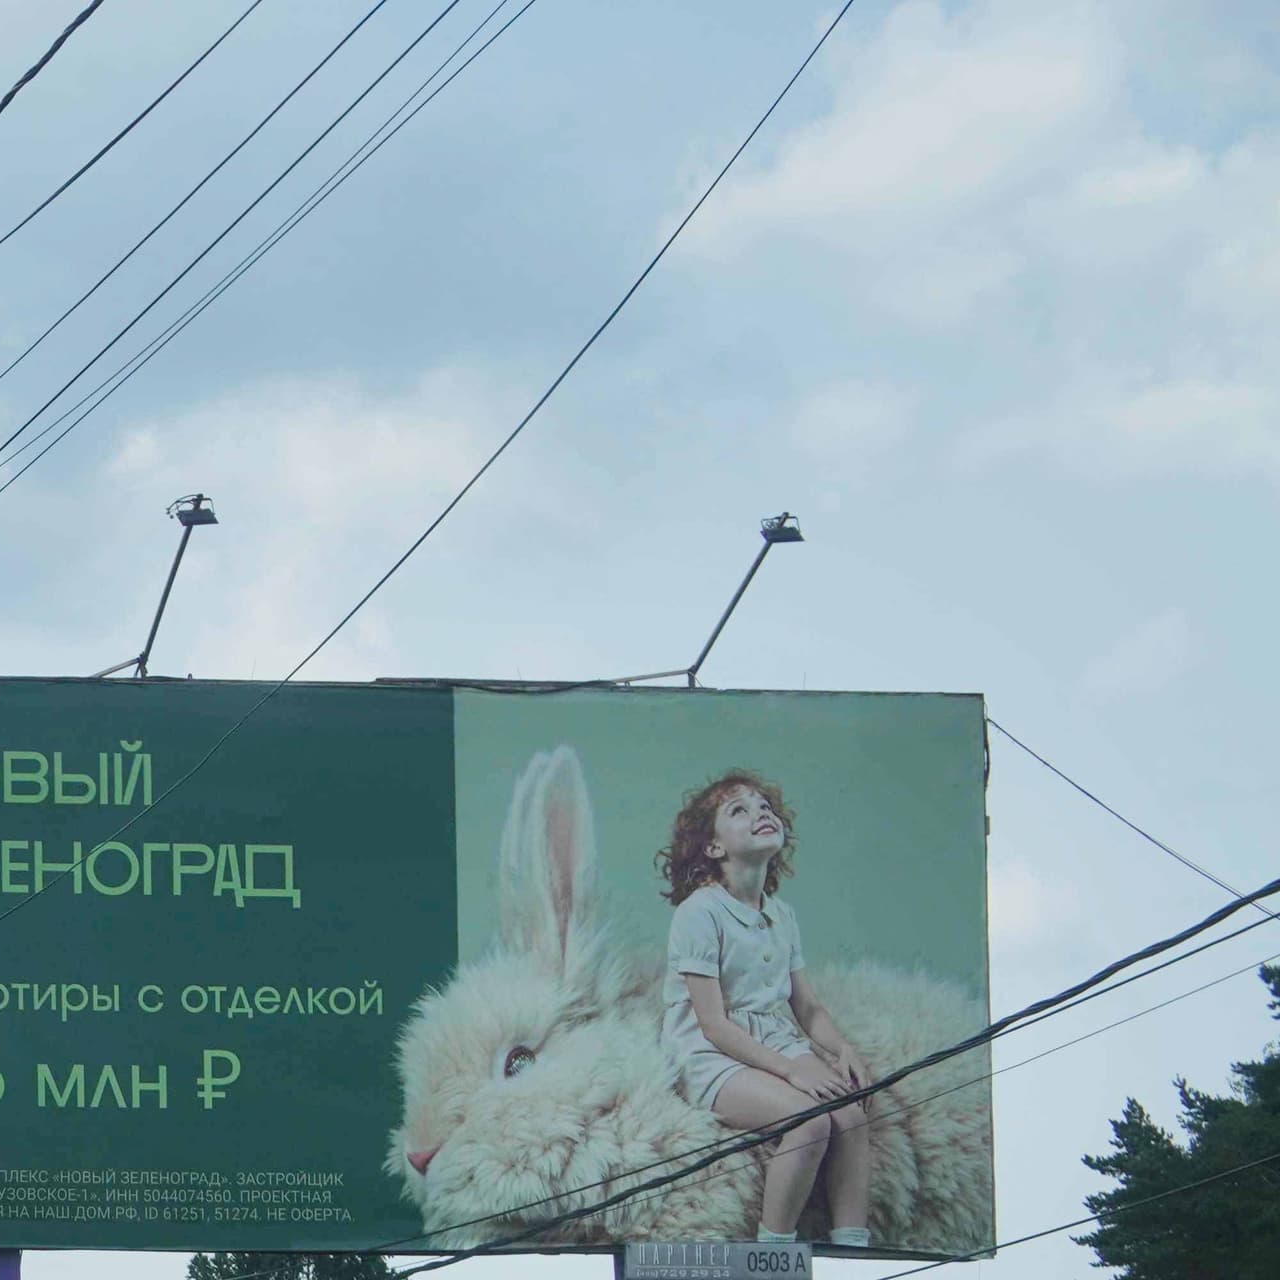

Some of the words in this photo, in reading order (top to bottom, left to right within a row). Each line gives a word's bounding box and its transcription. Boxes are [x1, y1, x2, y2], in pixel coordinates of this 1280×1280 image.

[138, 983, 164, 1013] с
[180, 980, 384, 1019] отделкой
[36, 1063, 168, 1109] млн
[52, 1168, 117, 1184] «НОВЫЙ
[236, 1170, 345, 1188] ЗАСТРОЙЩИК
[106, 1189, 138, 1202] ИНН
[239, 1190, 332, 1204] ПРОЕКТНАЯ
[8, 1205, 30, 1218] НА
[144, 1207, 159, 1220] ID
[267, 1208, 286, 1221] НЕ
[290, 1208, 356, 1222] ОФЕРТА.
[747, 1251, 790, 1273] 0503
